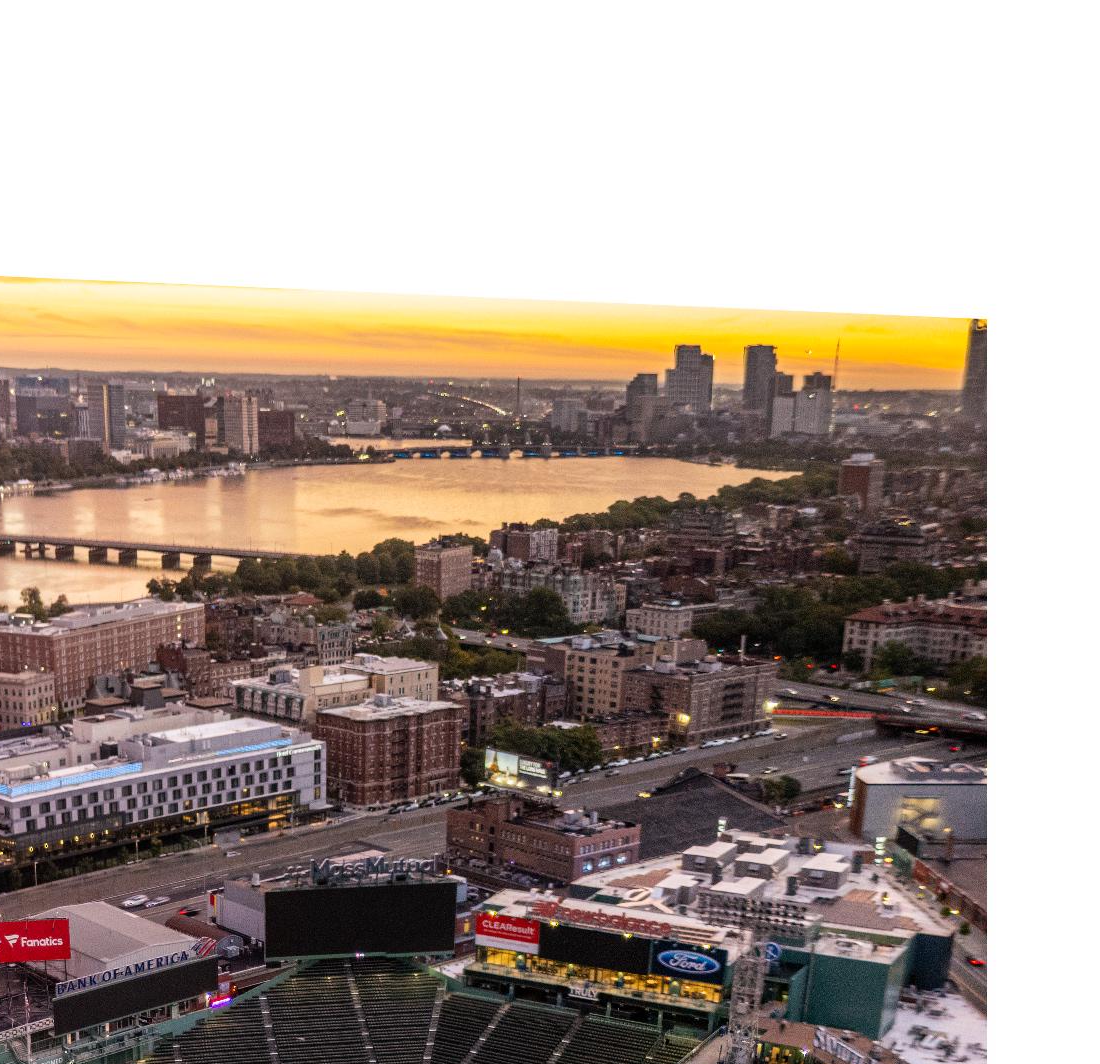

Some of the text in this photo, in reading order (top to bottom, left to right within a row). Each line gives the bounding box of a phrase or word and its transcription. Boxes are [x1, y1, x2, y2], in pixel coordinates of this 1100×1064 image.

[482, 920, 536, 935] CLEAResult
[21, 936, 63, 947] Fanatics
[669, 953, 707, 971] Ford
[57, 951, 190, 995] BANK OF AMERICA
[569, 985, 598, 999] TRULY
